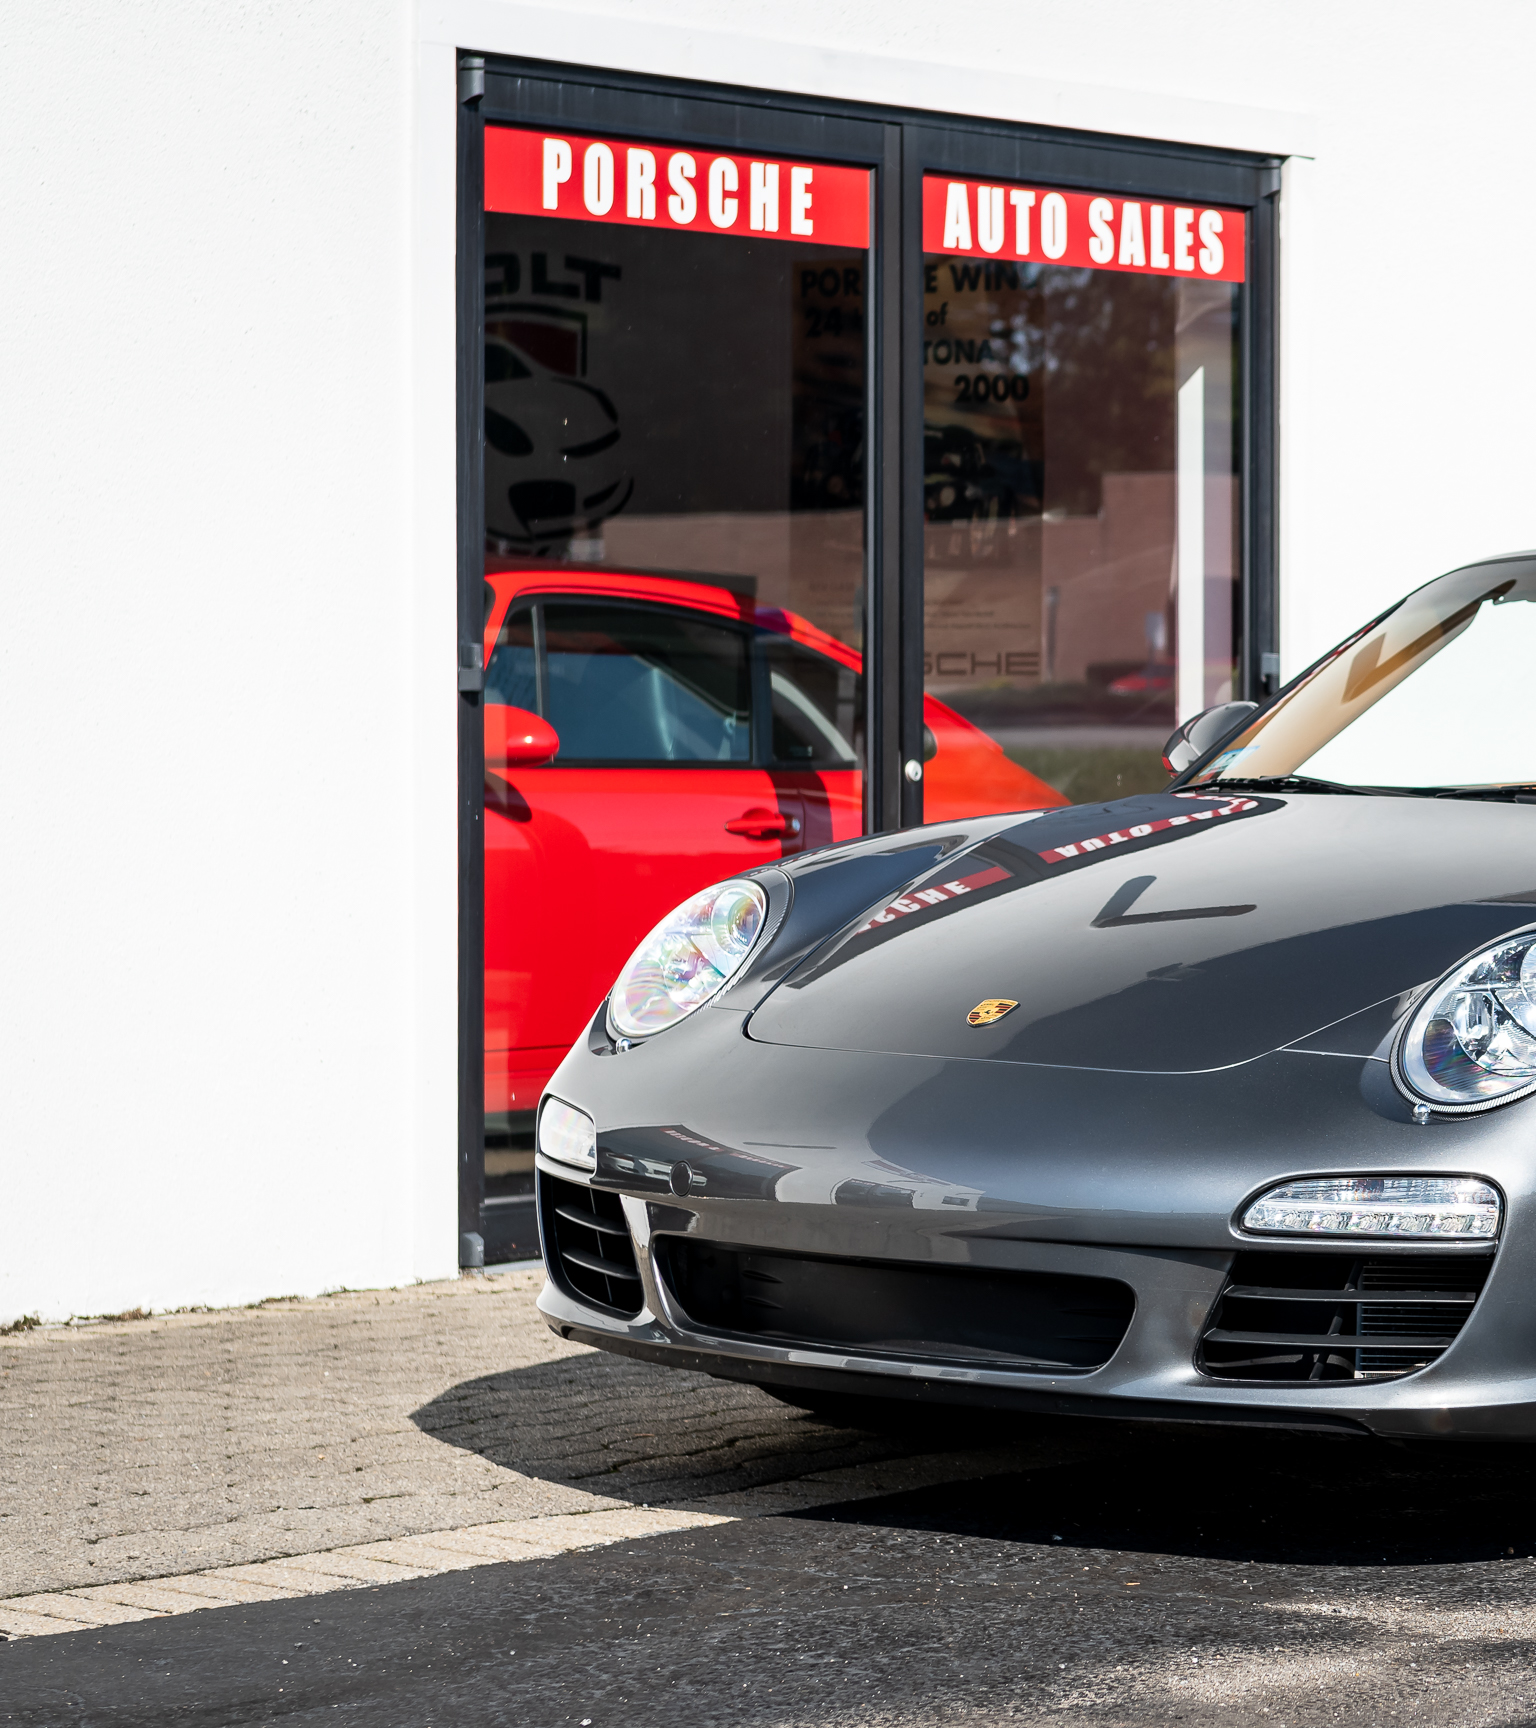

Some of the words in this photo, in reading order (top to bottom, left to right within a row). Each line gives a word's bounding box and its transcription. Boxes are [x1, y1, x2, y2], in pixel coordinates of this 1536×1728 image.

[542, 136, 815, 237] PORSCHE
[943, 182, 1069, 260] AUTO
[1087, 196, 1226, 276] SALES
[926, 302, 948, 326] of
[955, 374, 1029, 402] 2000
